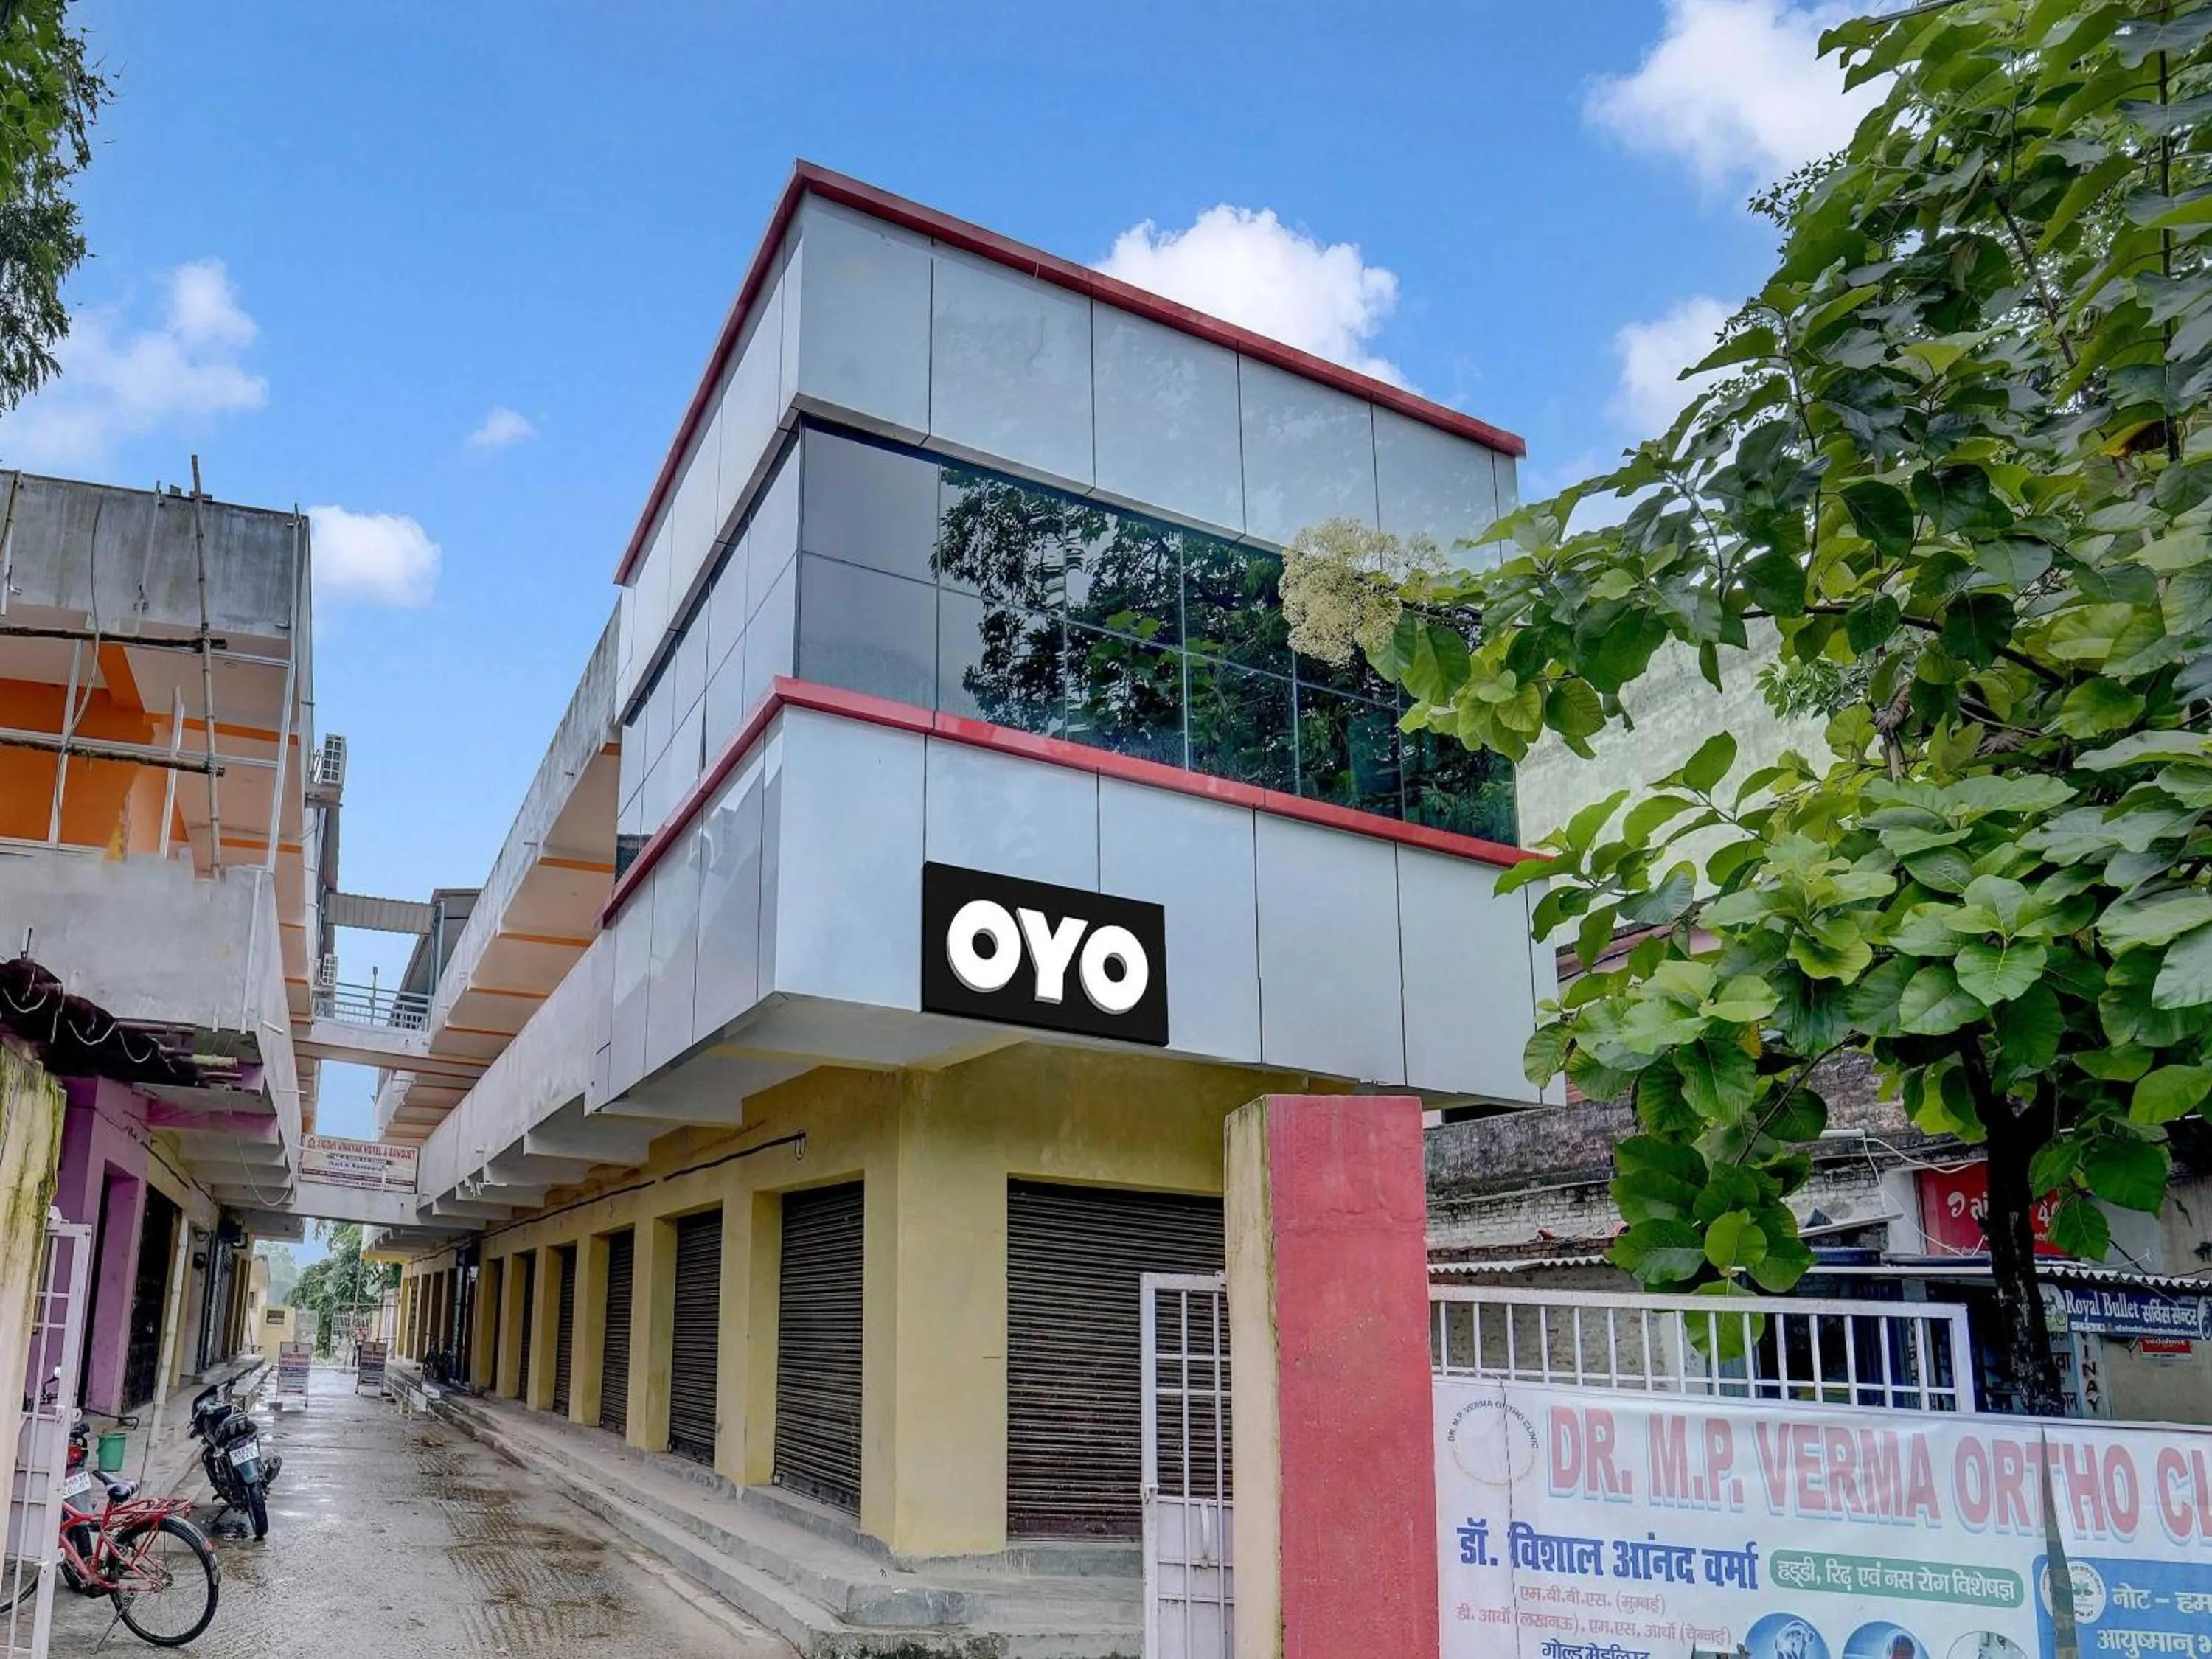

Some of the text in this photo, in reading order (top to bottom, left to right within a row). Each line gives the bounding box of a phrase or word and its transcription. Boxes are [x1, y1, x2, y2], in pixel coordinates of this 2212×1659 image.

[947, 899, 1149, 1015] OYO
[2065, 1290, 2101, 1322] Royal
[2101, 1293, 2140, 1318] Bullet
[1548, 1405, 1632, 1503] DR.
[1646, 1413, 1745, 1513] M.P.
[1752, 1420, 1941, 1528] VERMA
[1952, 1434, 2139, 1543] ORTHO
[1457, 1517, 1498, 1567] डॉ.
[1508, 1521, 1604, 1576] विशाल
[1701, 1541, 1759, 1590] वर्मा
[1857, 1561, 1882, 1587] एवं
[1884, 1568, 1915, 1590] नस
[1917, 1566, 1950, 1593] रोग
[1952, 1568, 2016, 1601] विशेषज्ञ
[2112, 1582, 2152, 1610] नोट
